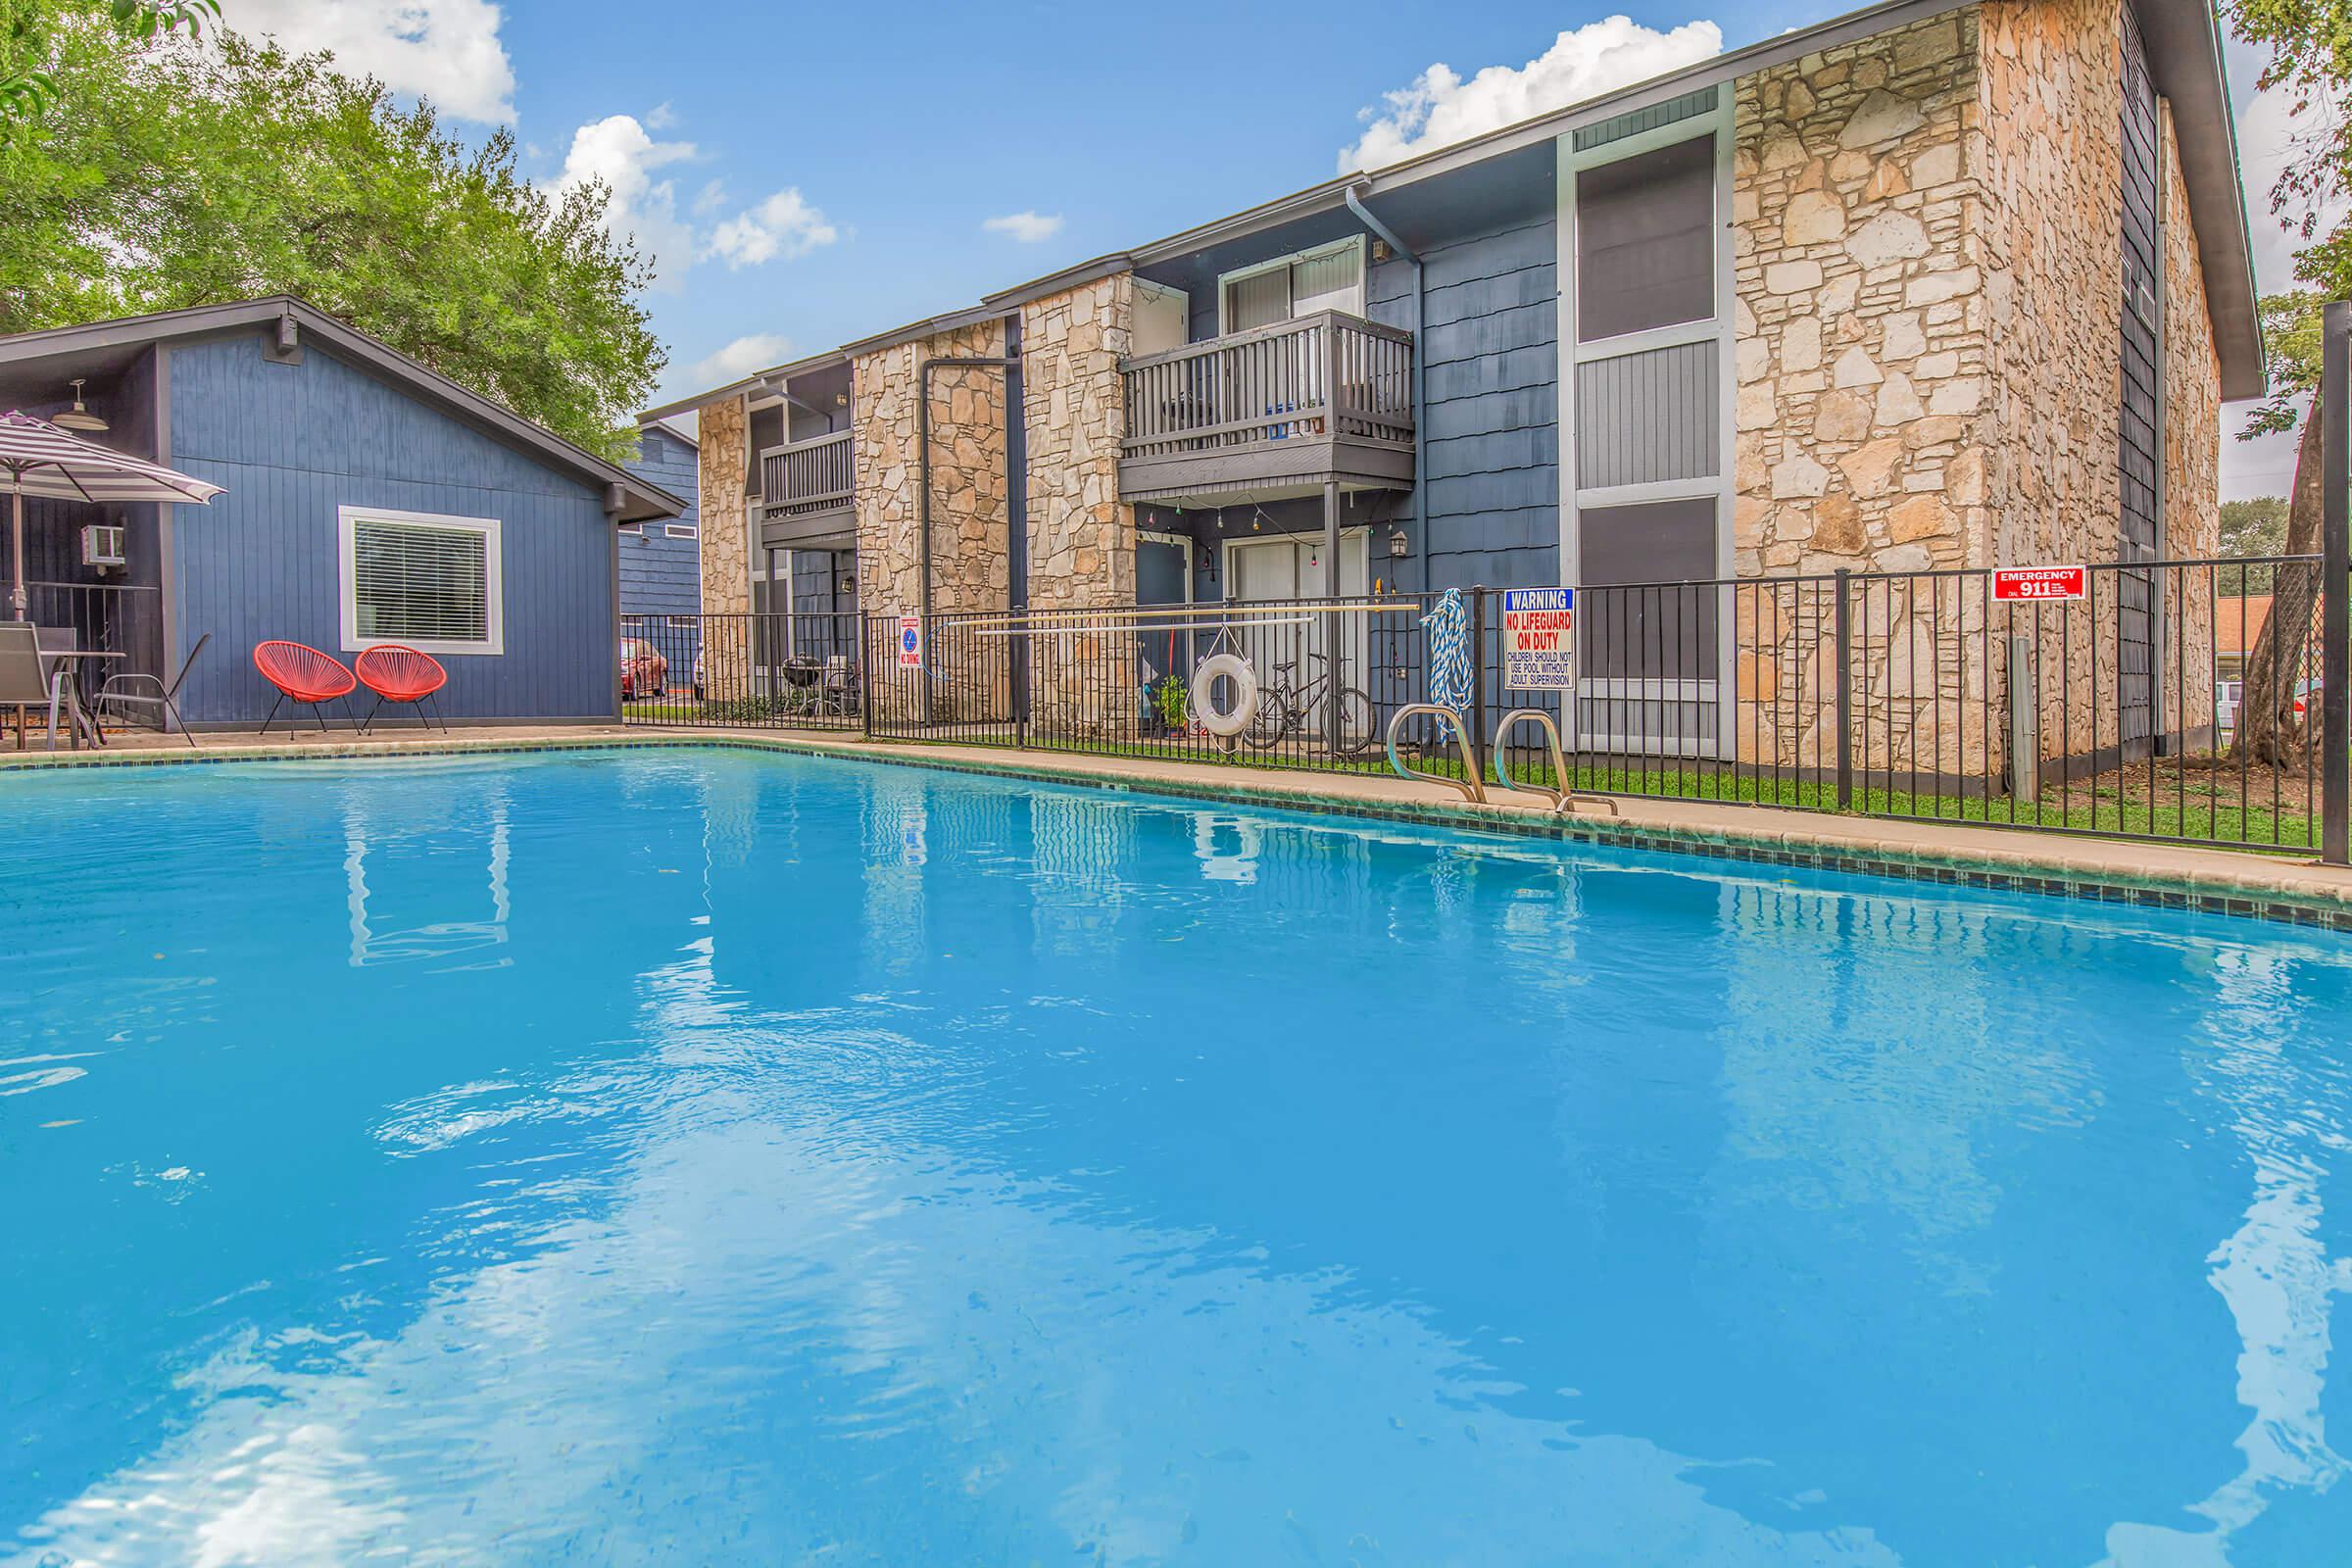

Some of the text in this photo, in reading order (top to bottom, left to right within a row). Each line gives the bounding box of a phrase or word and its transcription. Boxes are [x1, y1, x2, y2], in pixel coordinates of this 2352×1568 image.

[2000, 570, 2076, 581] EMERGENCY
[2020, 582, 2050, 596] 911
[1511, 591, 1566, 610] WARNING
[1507, 612, 1570, 630] NO LIFEGUARD
[1518, 632, 1558, 650] ON DUTY
[1507, 652, 1571, 662] CHILDREN SHOULD NOT
[1511, 663, 1568, 673] USE POOL WITHOUT
[1510, 674, 1569, 685] ADULT SUPERVISION
